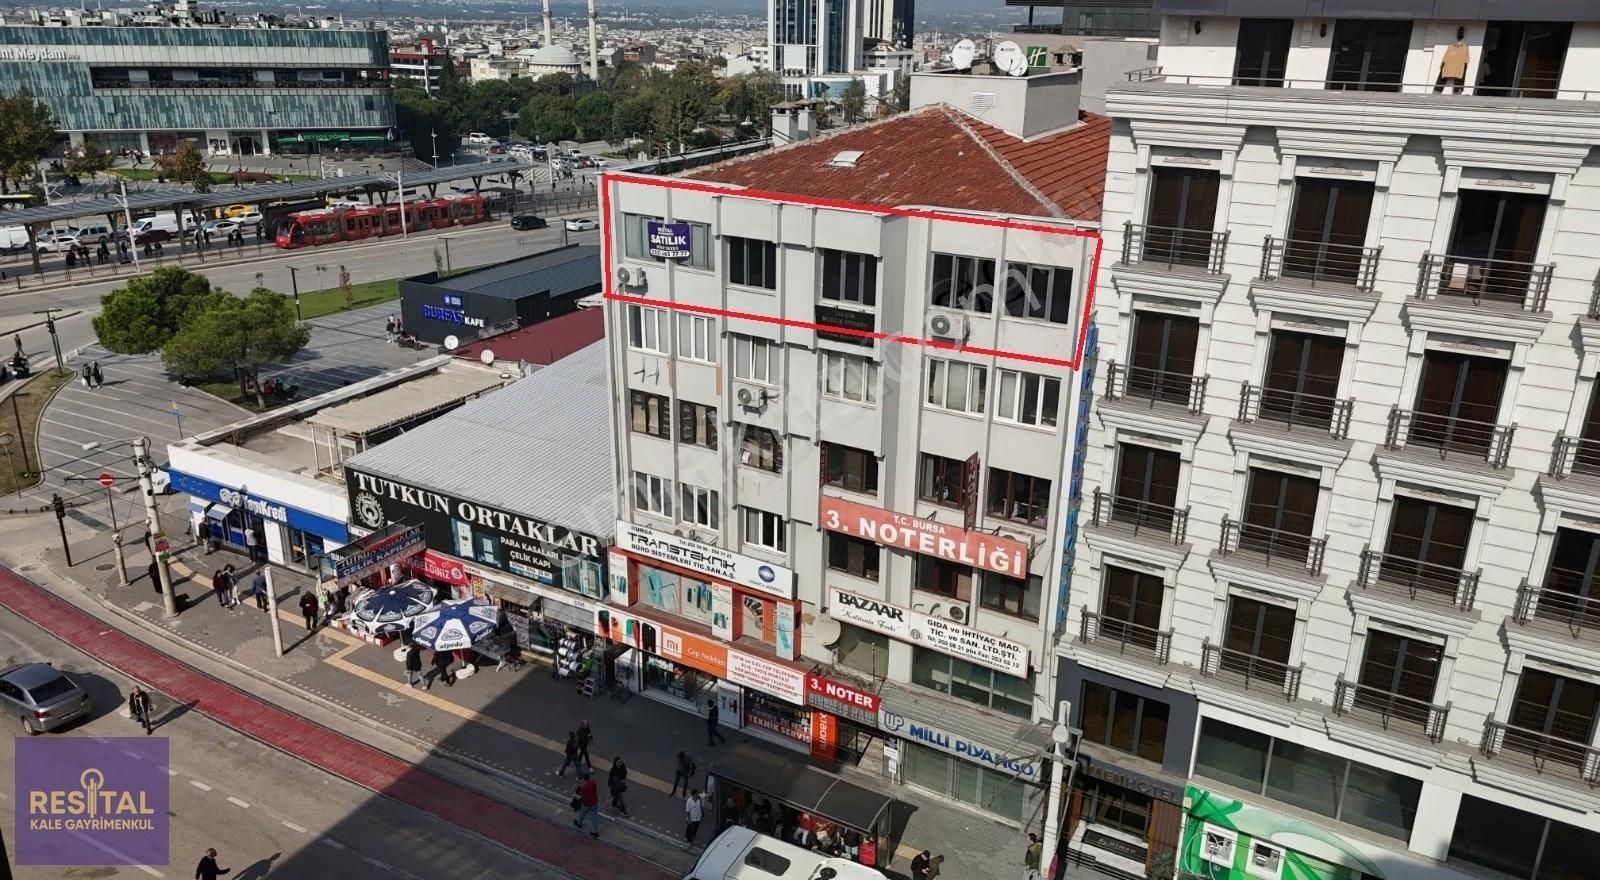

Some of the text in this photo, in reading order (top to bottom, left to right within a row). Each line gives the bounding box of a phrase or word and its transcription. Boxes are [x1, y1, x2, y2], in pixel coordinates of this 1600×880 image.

[651, 234, 687, 245] SATILIK
[465, 316, 484, 328] KAFE
[353, 471, 600, 558] TUTKUN ORTAKLAR
[912, 519, 946, 535] BURSA
[500, 536, 559, 559] PARA KASALARI
[631, 543, 650, 553] BÜRO
[651, 548, 692, 565] SİSTEMLERİ
[826, 509, 1023, 575] 3. NOTERLİĞİ
[509, 550, 551, 569] ÇELİK KAPI
[836, 591, 904, 623] BAZAAR
[927, 619, 948, 631] GIDA
[961, 629, 996, 646] İHTİYAÇ
[998, 641, 1022, 653] MAD.
[930, 627, 946, 638] TİC.
[960, 638, 980, 649] SAN.
[982, 644, 1017, 661] LTD.ŞTİ.
[687, 647, 727, 667] Cep Noktası
[810, 678, 822, 691] 3.
[826, 683, 873, 709] NOTER
[748, 713, 780, 734] TEKNİK
[781, 726, 811, 744] SERVİS
